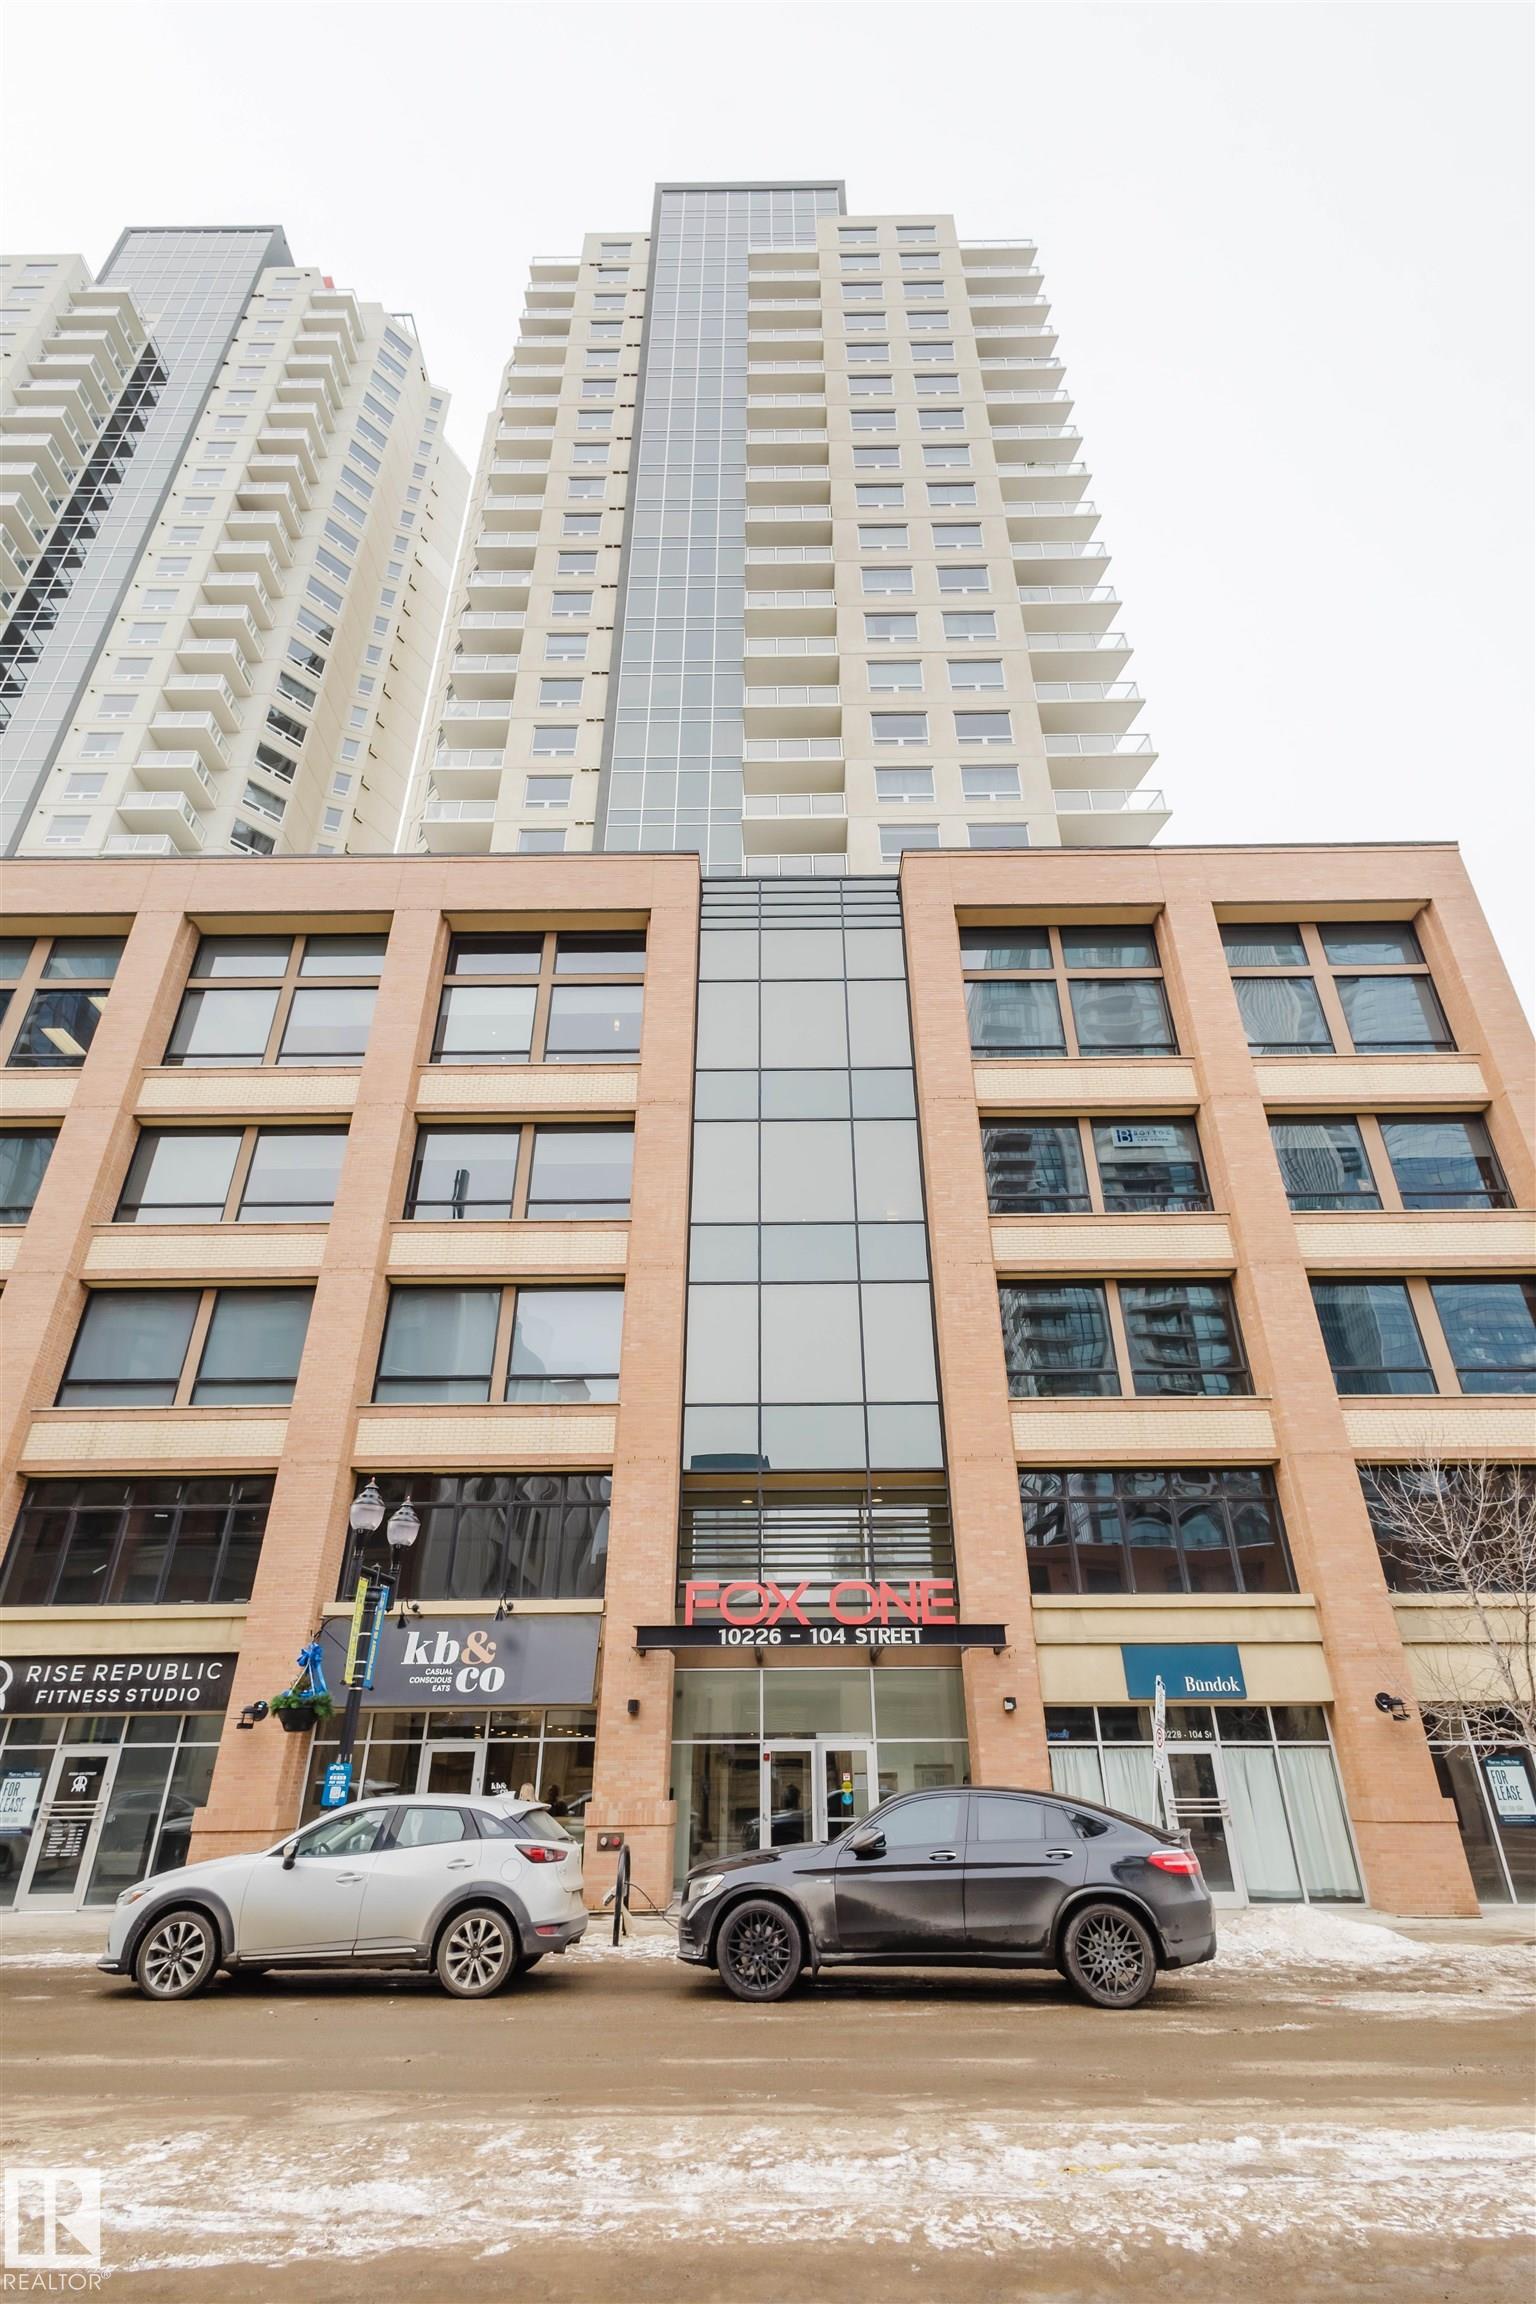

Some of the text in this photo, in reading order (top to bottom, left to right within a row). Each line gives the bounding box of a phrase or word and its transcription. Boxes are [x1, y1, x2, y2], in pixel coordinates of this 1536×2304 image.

[685, 1580, 956, 1625] FOX ONE
[718, 1628, 782, 1645] 10226
[809, 1628, 846, 1644] 104
[855, 1627, 923, 1644] STREET
[400, 1630, 497, 1665] kb&
[25, 1662, 223, 1683] RISE REPUBLIC
[409, 1676, 452, 1684] CONSCIOUS
[455, 1666, 505, 1693] co
[432, 1684, 451, 1692] EATS
[1183, 1676, 1241, 1692] Bundok
[35, 1687, 201, 1704] FITNESS STUDIO
[1490, 1769, 1509, 1785] FOR
[3, 1781, 21, 1797] FOR
[1494, 1785, 1524, 1801] LEASE
